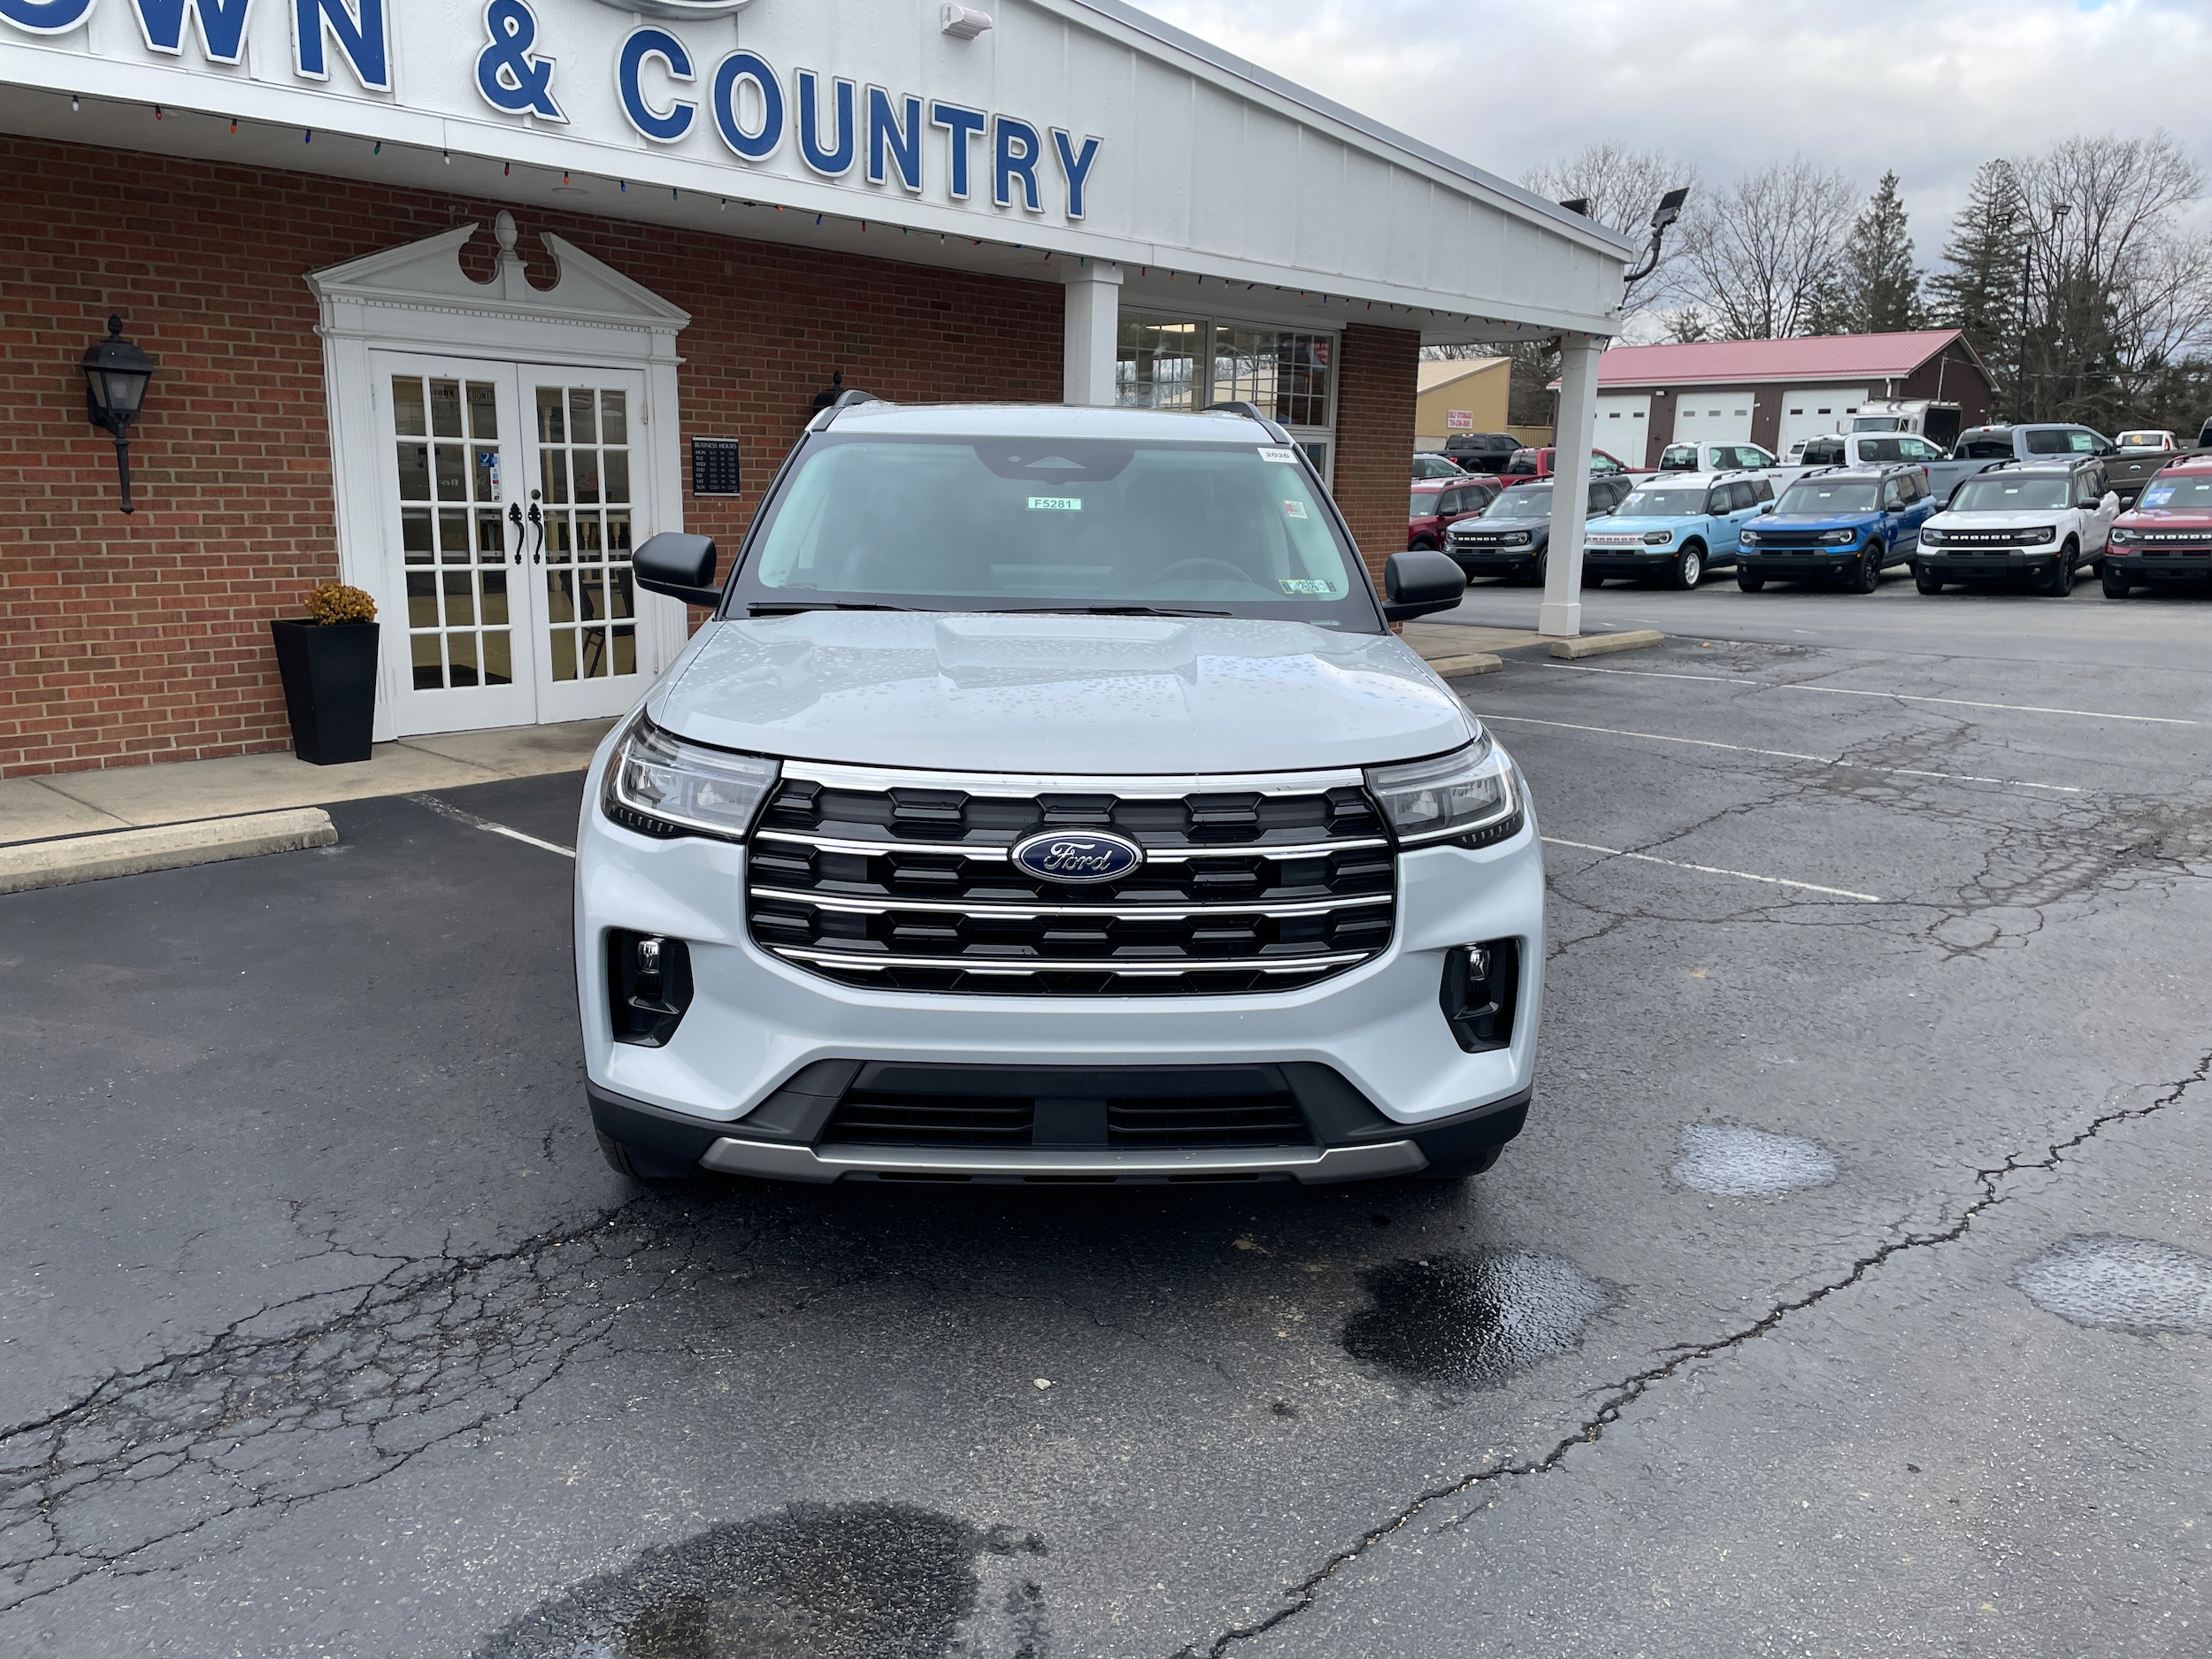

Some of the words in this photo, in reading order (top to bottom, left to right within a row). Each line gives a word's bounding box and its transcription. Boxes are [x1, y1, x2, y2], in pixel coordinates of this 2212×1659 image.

[474, 0, 571, 125] &
[616, 24, 1104, 221] COUNTRY
[1034, 499, 1071, 509] F5281
[1043, 841, 1113, 872] Ford
